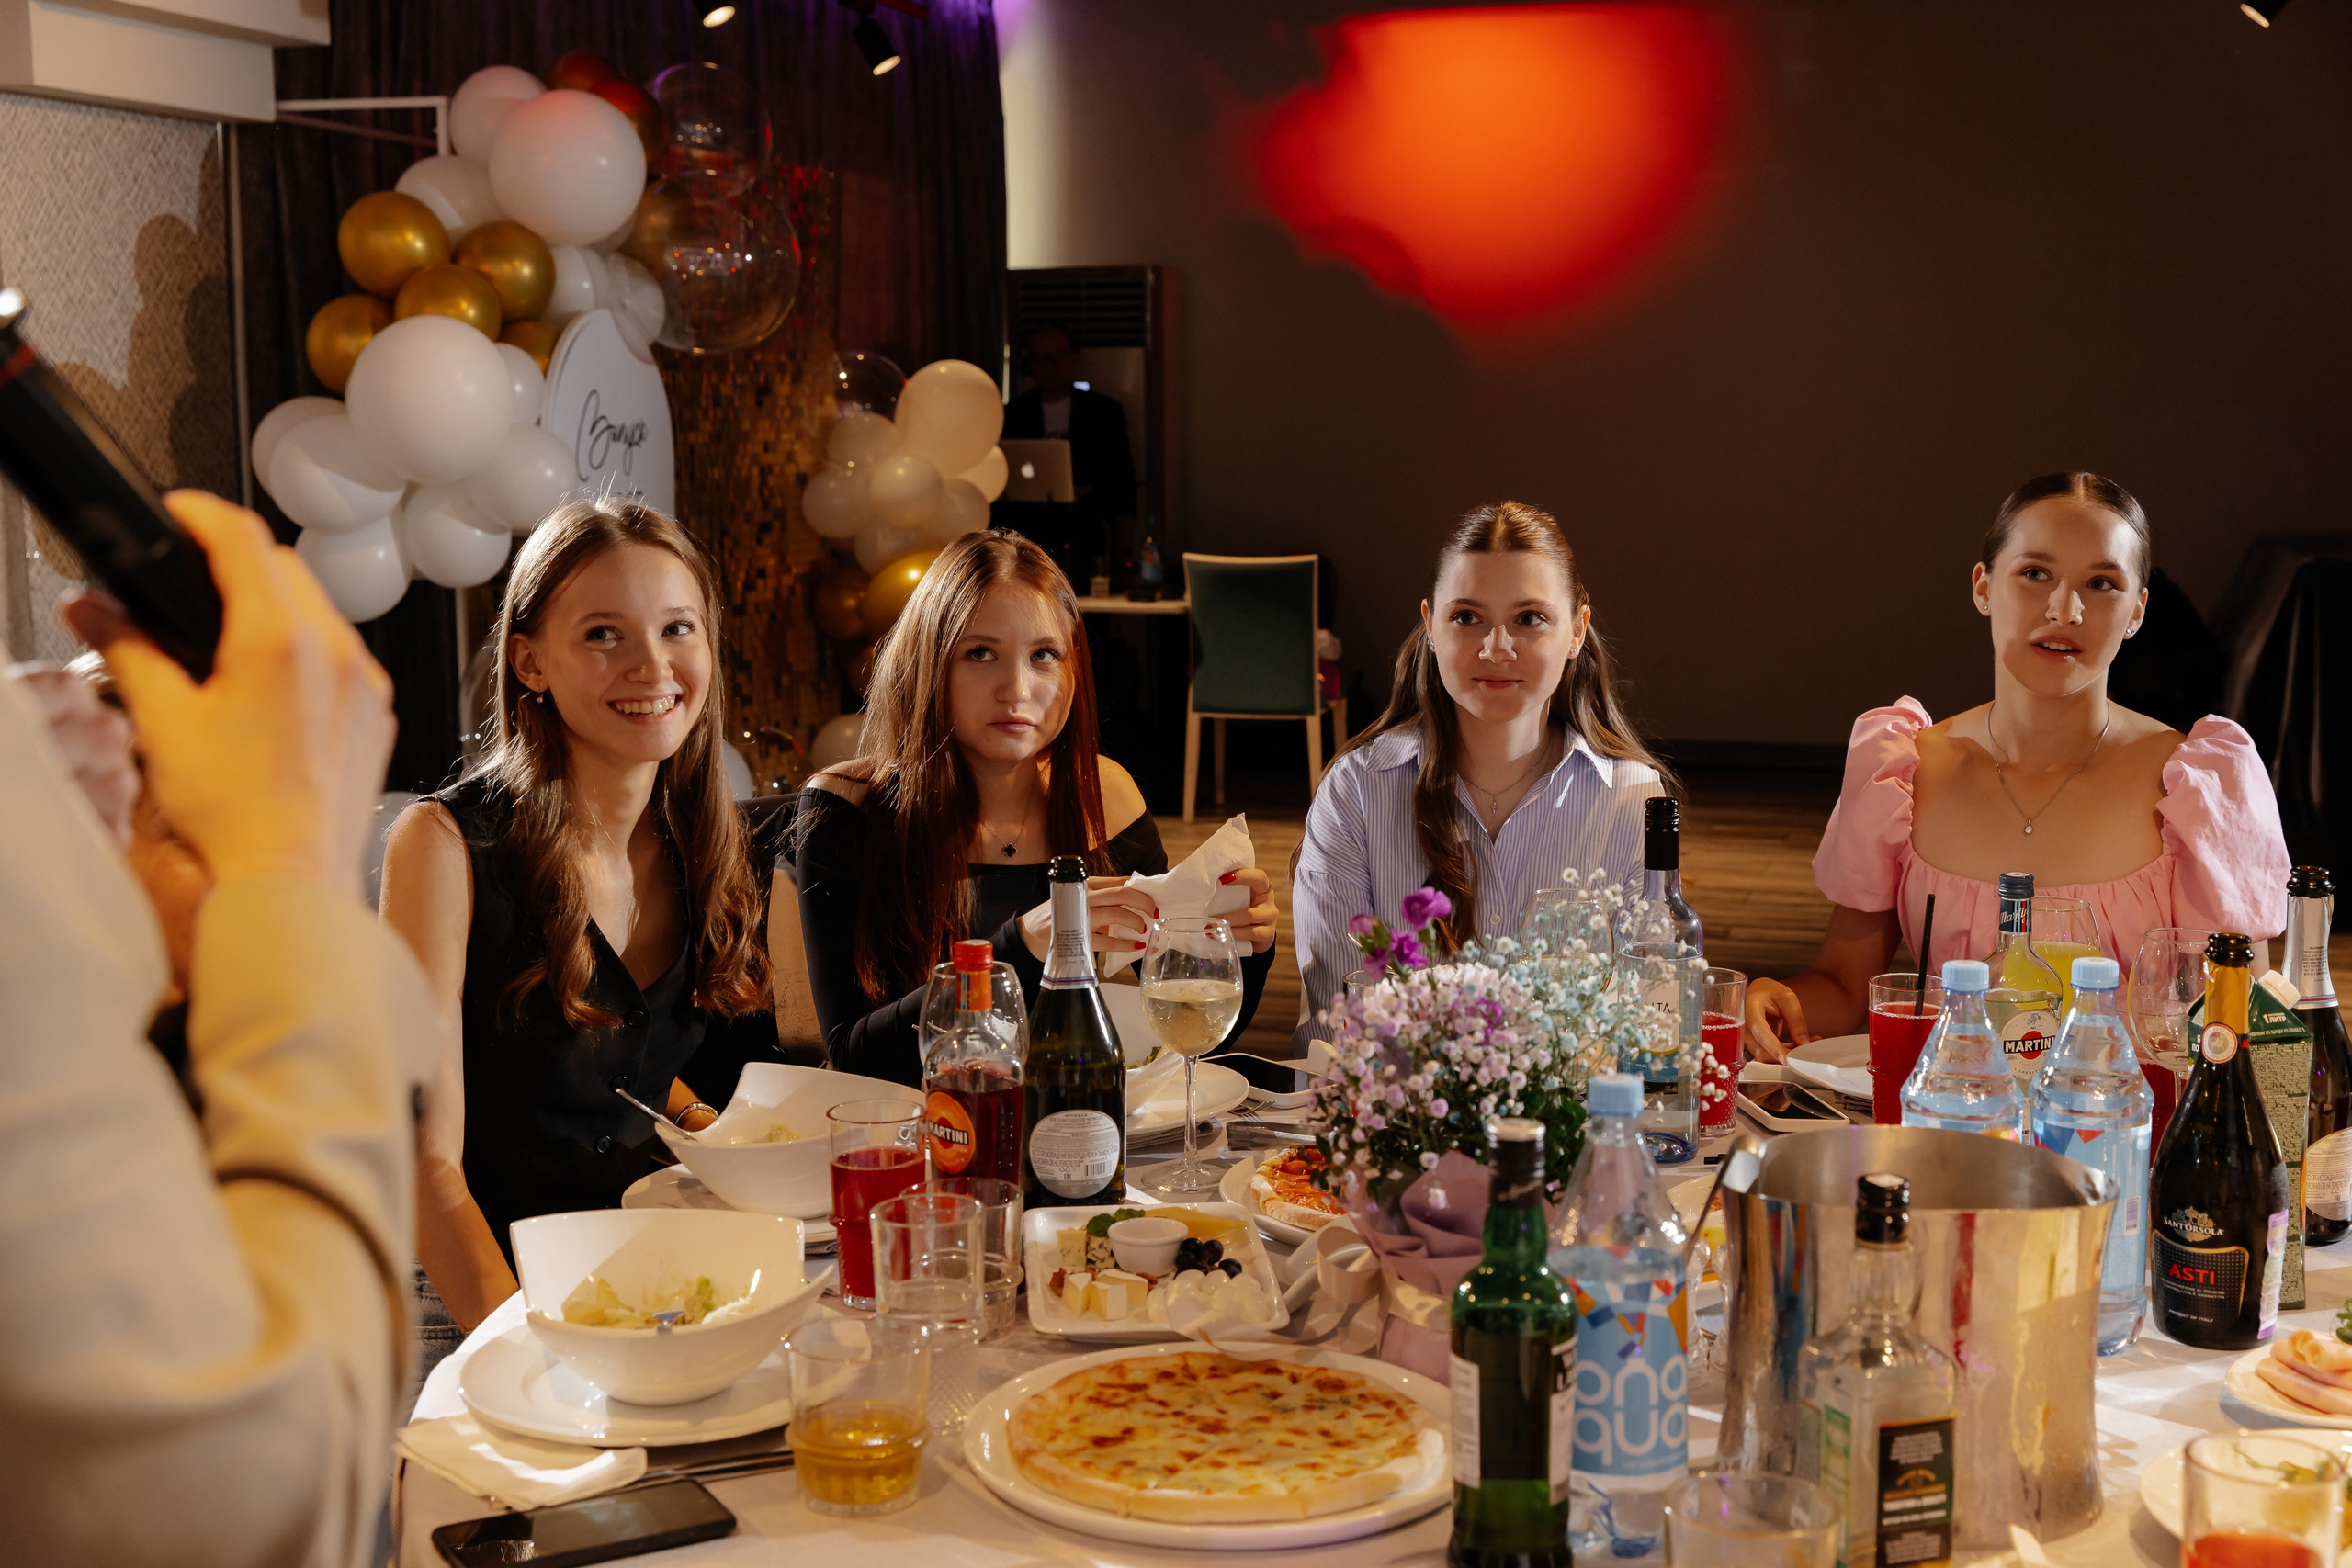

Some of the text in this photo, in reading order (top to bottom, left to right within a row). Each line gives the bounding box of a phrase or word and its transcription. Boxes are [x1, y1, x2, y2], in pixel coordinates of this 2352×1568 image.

[2269, 1015, 2287, 1024] ЛИТР
[929, 1120, 968, 1145] MARTINI
[2169, 1263, 2215, 1285] ASTI
